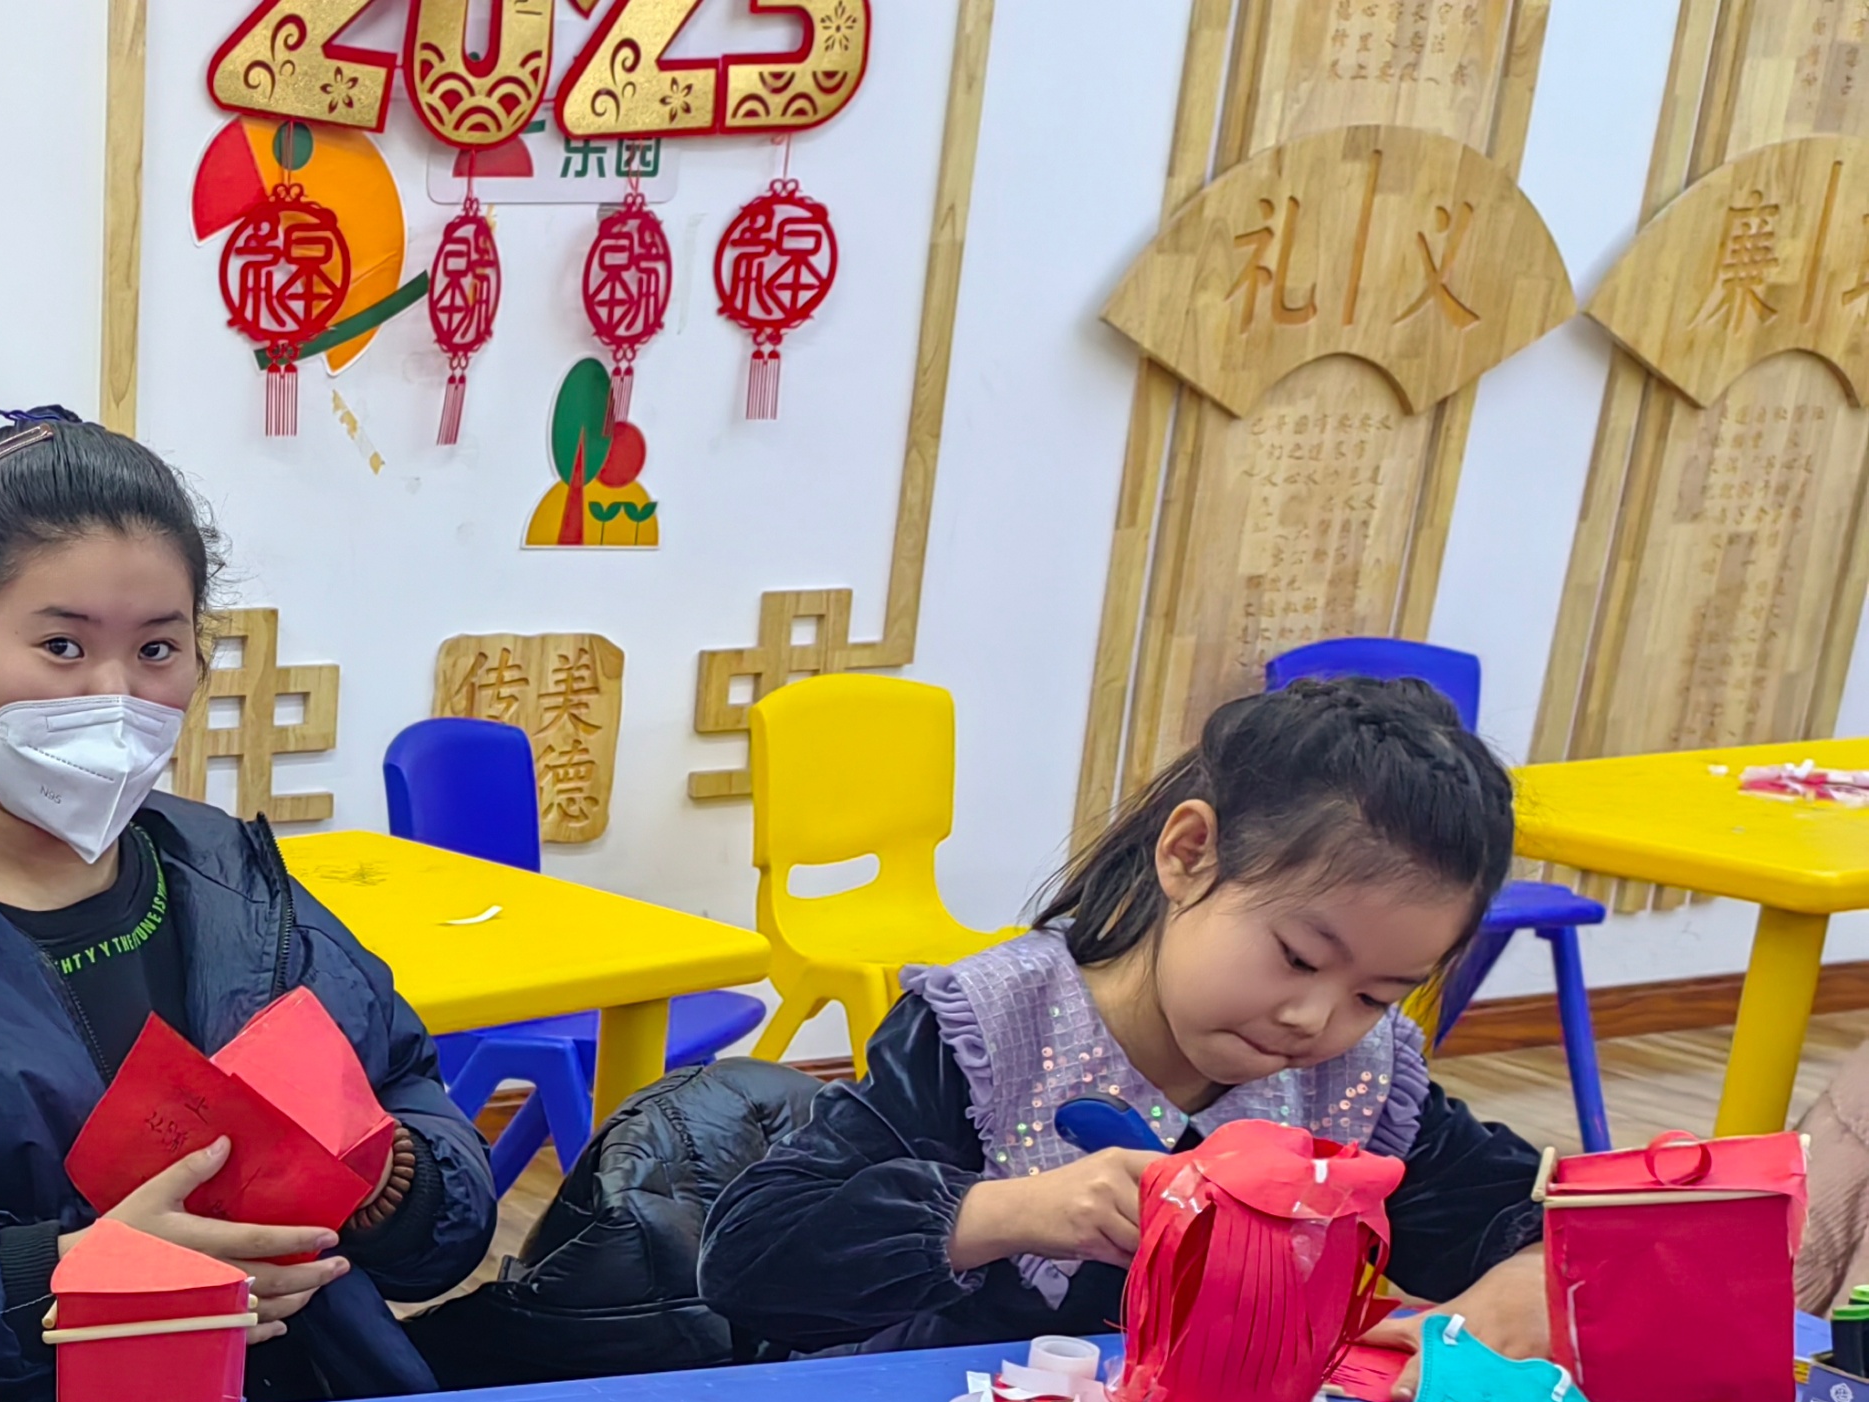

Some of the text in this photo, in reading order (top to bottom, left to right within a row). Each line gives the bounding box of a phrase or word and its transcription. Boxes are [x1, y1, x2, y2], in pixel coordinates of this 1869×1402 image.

[234, 206, 335, 328] 福
[726, 206, 828, 322] 福
[1225, 195, 1480, 336] 礼 义
[452, 647, 530, 722] 传
[533, 647, 603, 826] 美德
[40, 785, 62, 804] N95
